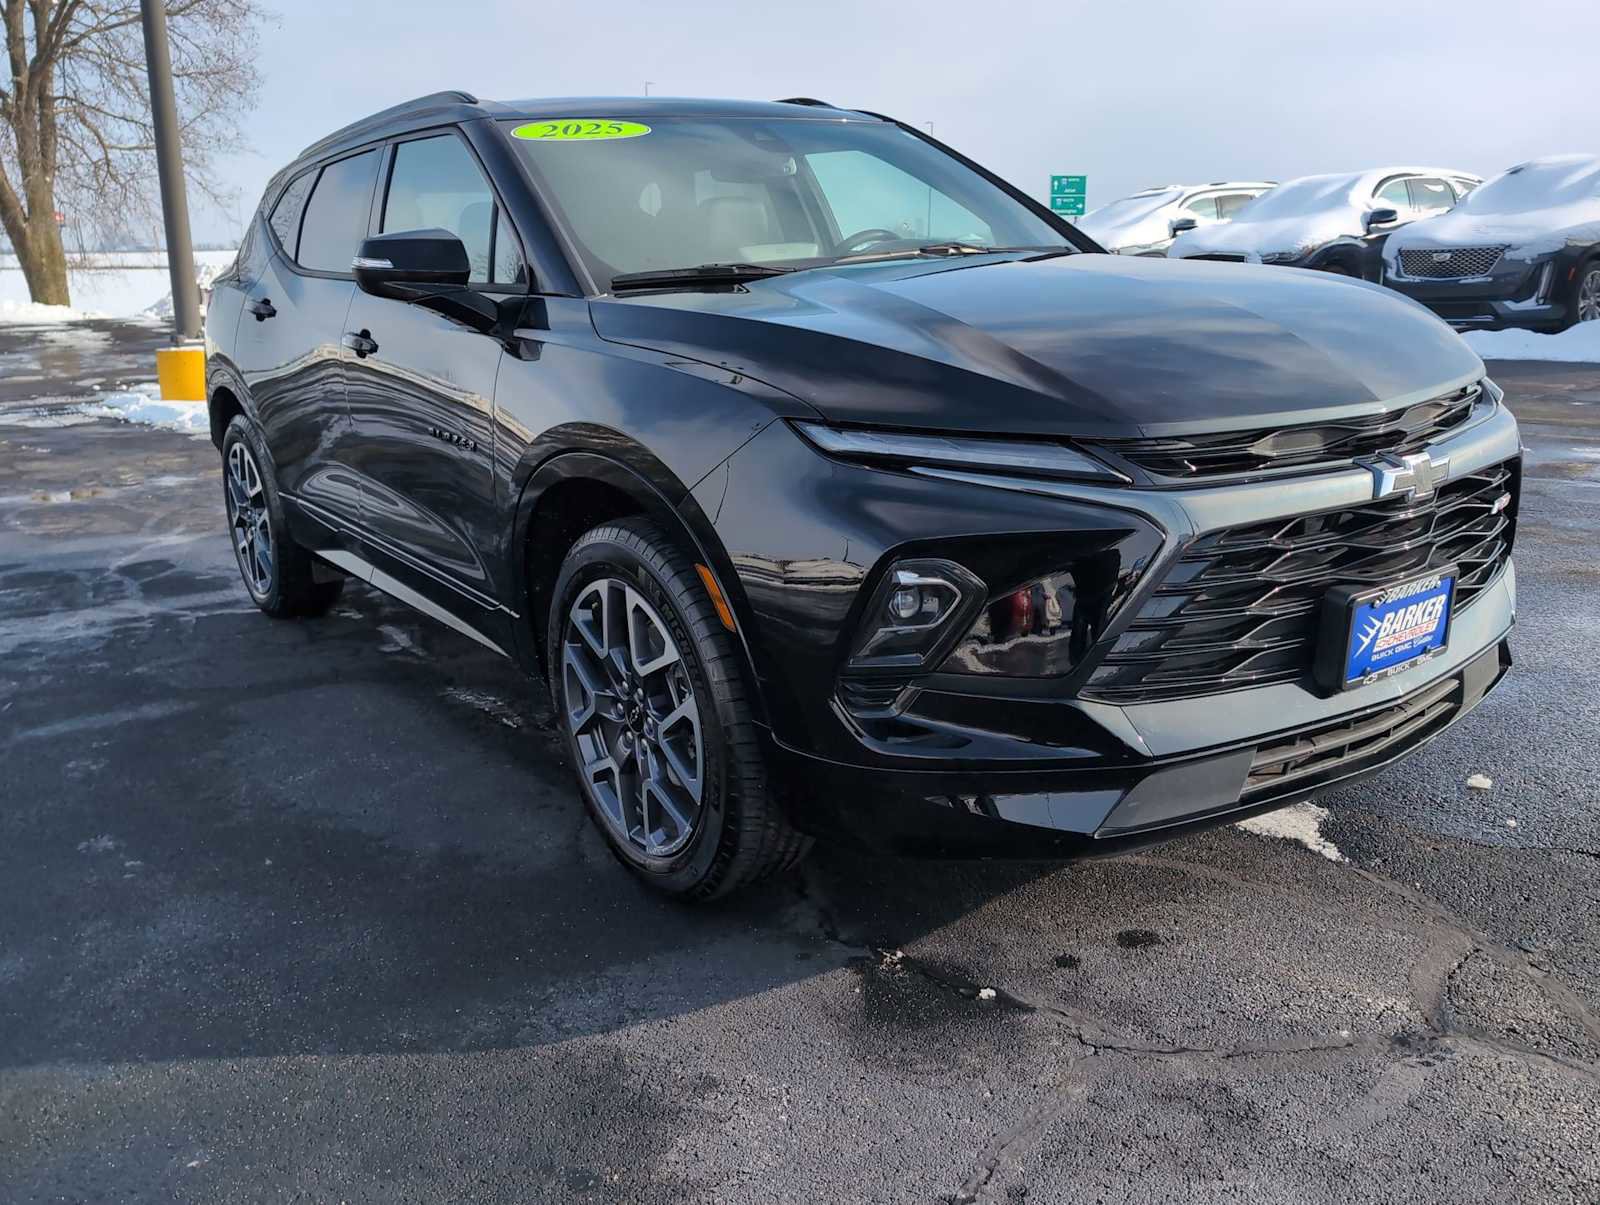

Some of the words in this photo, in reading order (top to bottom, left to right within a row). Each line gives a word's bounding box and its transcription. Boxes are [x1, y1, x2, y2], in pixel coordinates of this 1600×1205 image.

[540, 123, 624, 137] 2025
[1386, 575, 1440, 602] BARKER
[1378, 594, 1447, 638] BARKER
[1372, 648, 1393, 661] BUICK
[1387, 663, 1410, 676] BUICK
